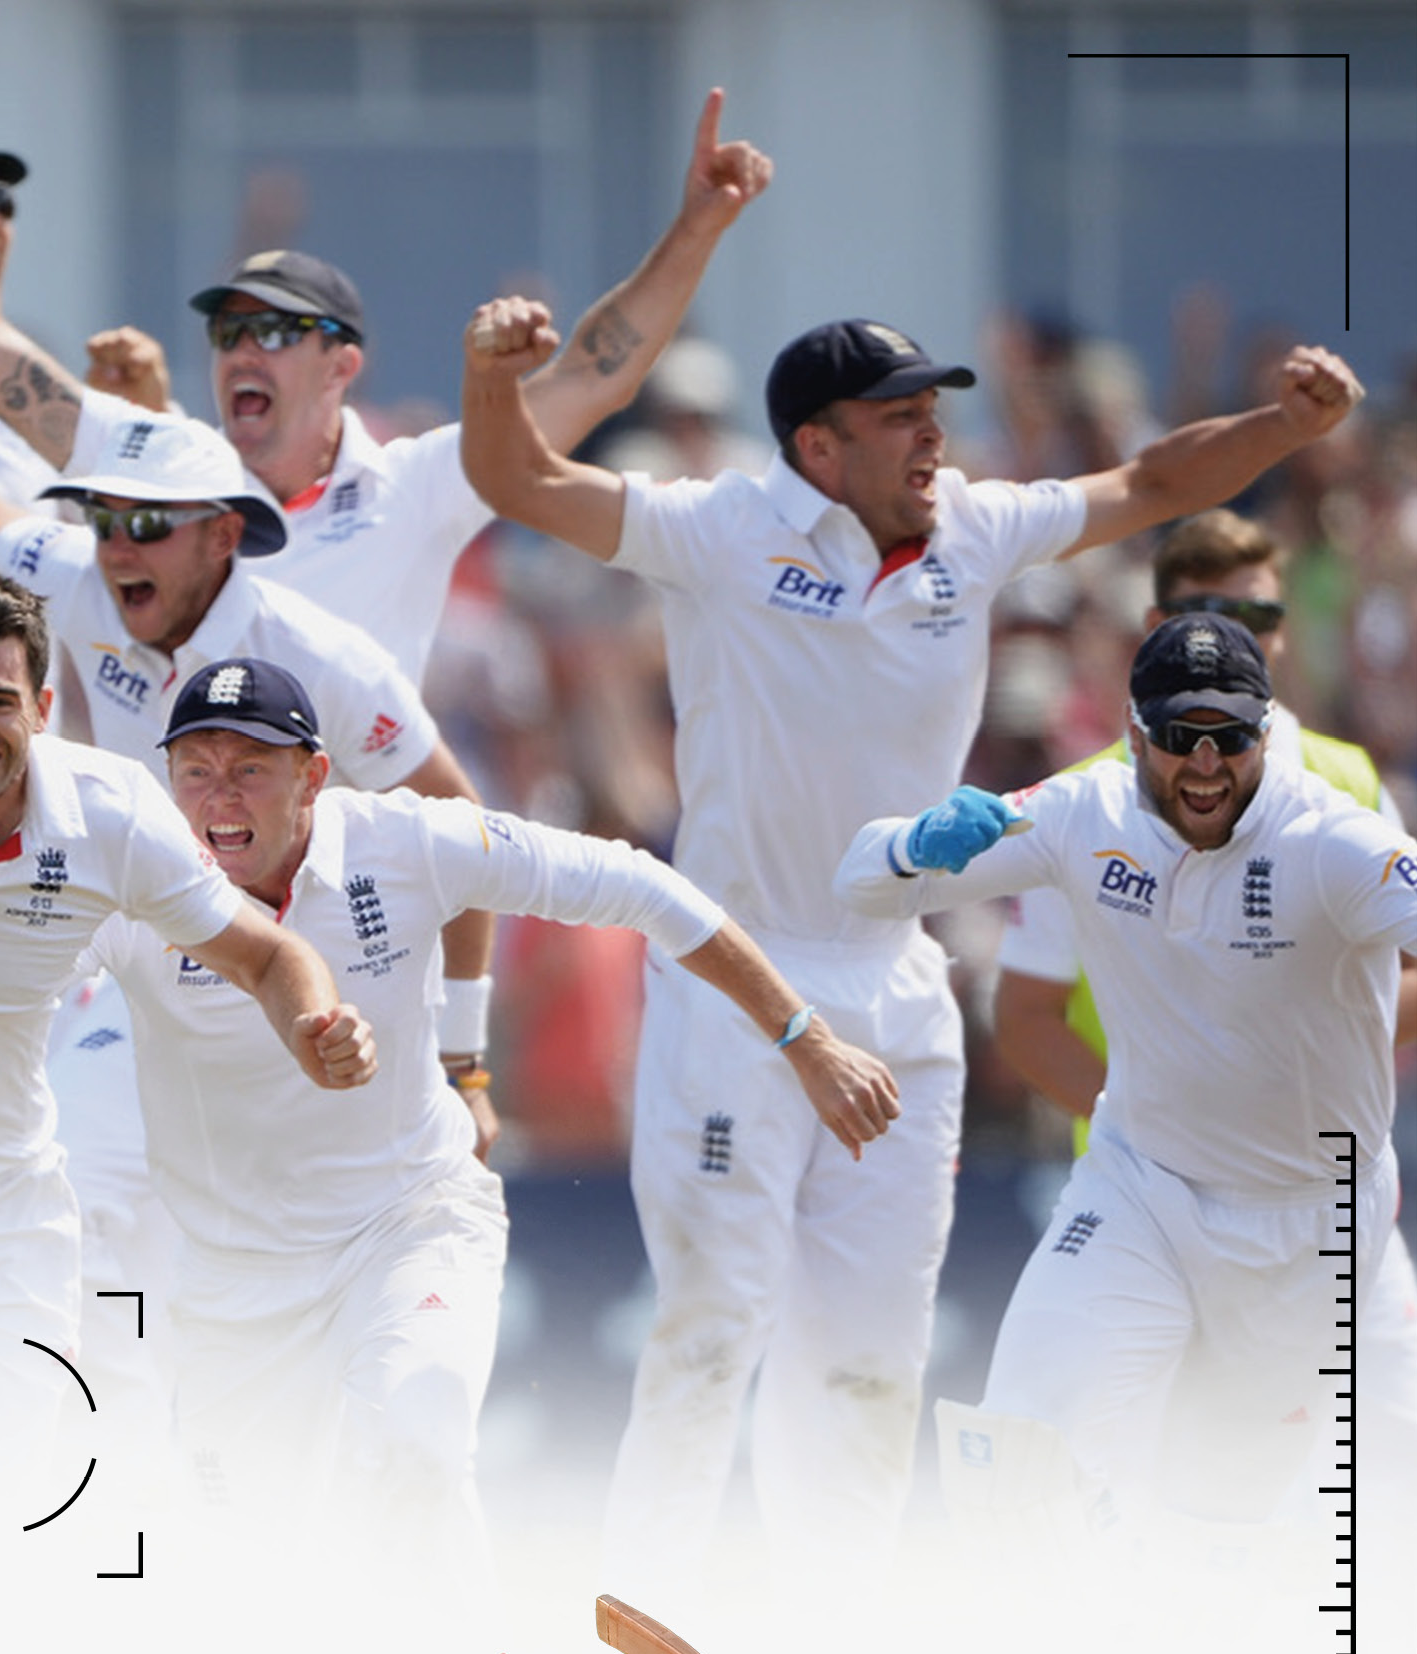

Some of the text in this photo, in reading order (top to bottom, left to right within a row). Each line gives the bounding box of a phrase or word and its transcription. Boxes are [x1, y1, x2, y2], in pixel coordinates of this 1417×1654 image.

[776, 565, 846, 607] Brit
[98, 653, 150, 704] Brit
[1101, 858, 1158, 905] Brit
